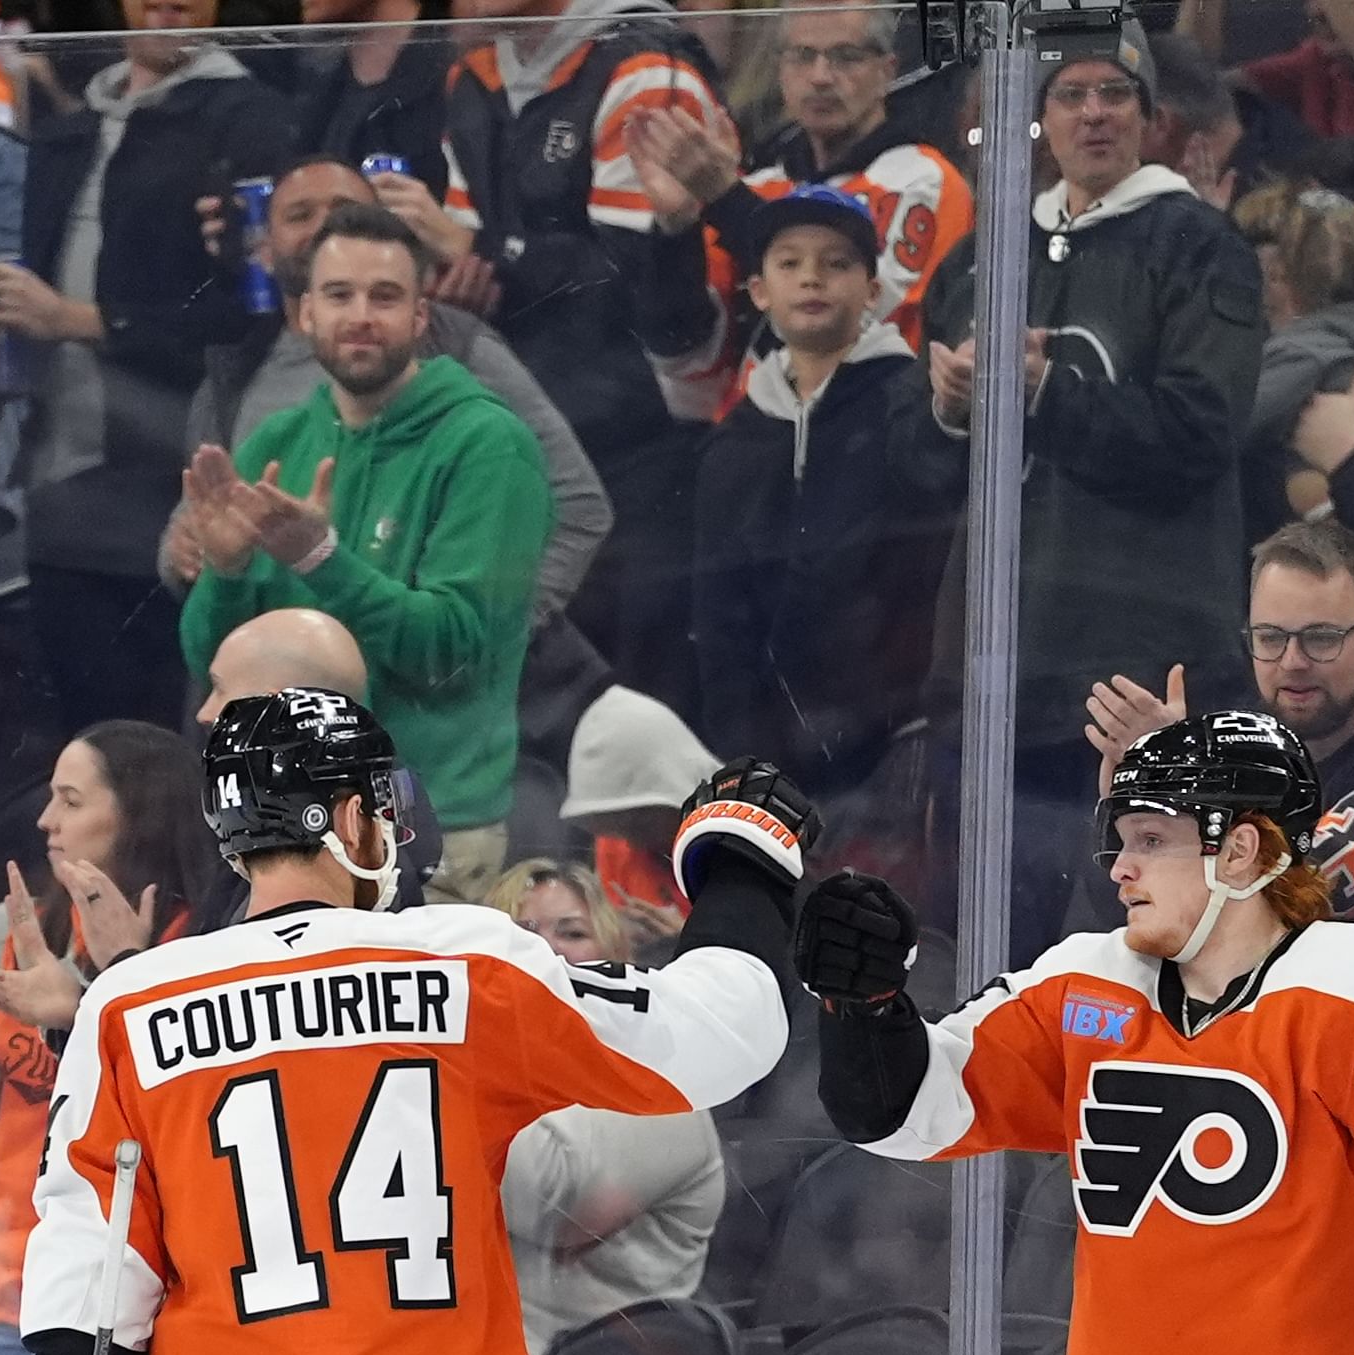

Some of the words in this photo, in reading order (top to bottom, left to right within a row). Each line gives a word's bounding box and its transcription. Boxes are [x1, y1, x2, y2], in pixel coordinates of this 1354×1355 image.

[296, 714, 359, 731] CHEVROLET
[217, 772, 242, 810] 14
[1112, 768, 1139, 785] CCM
[147, 969, 450, 1071] COUTURIER
[1061, 1002, 1128, 1045] IBX
[207, 1057, 458, 1326] 14
